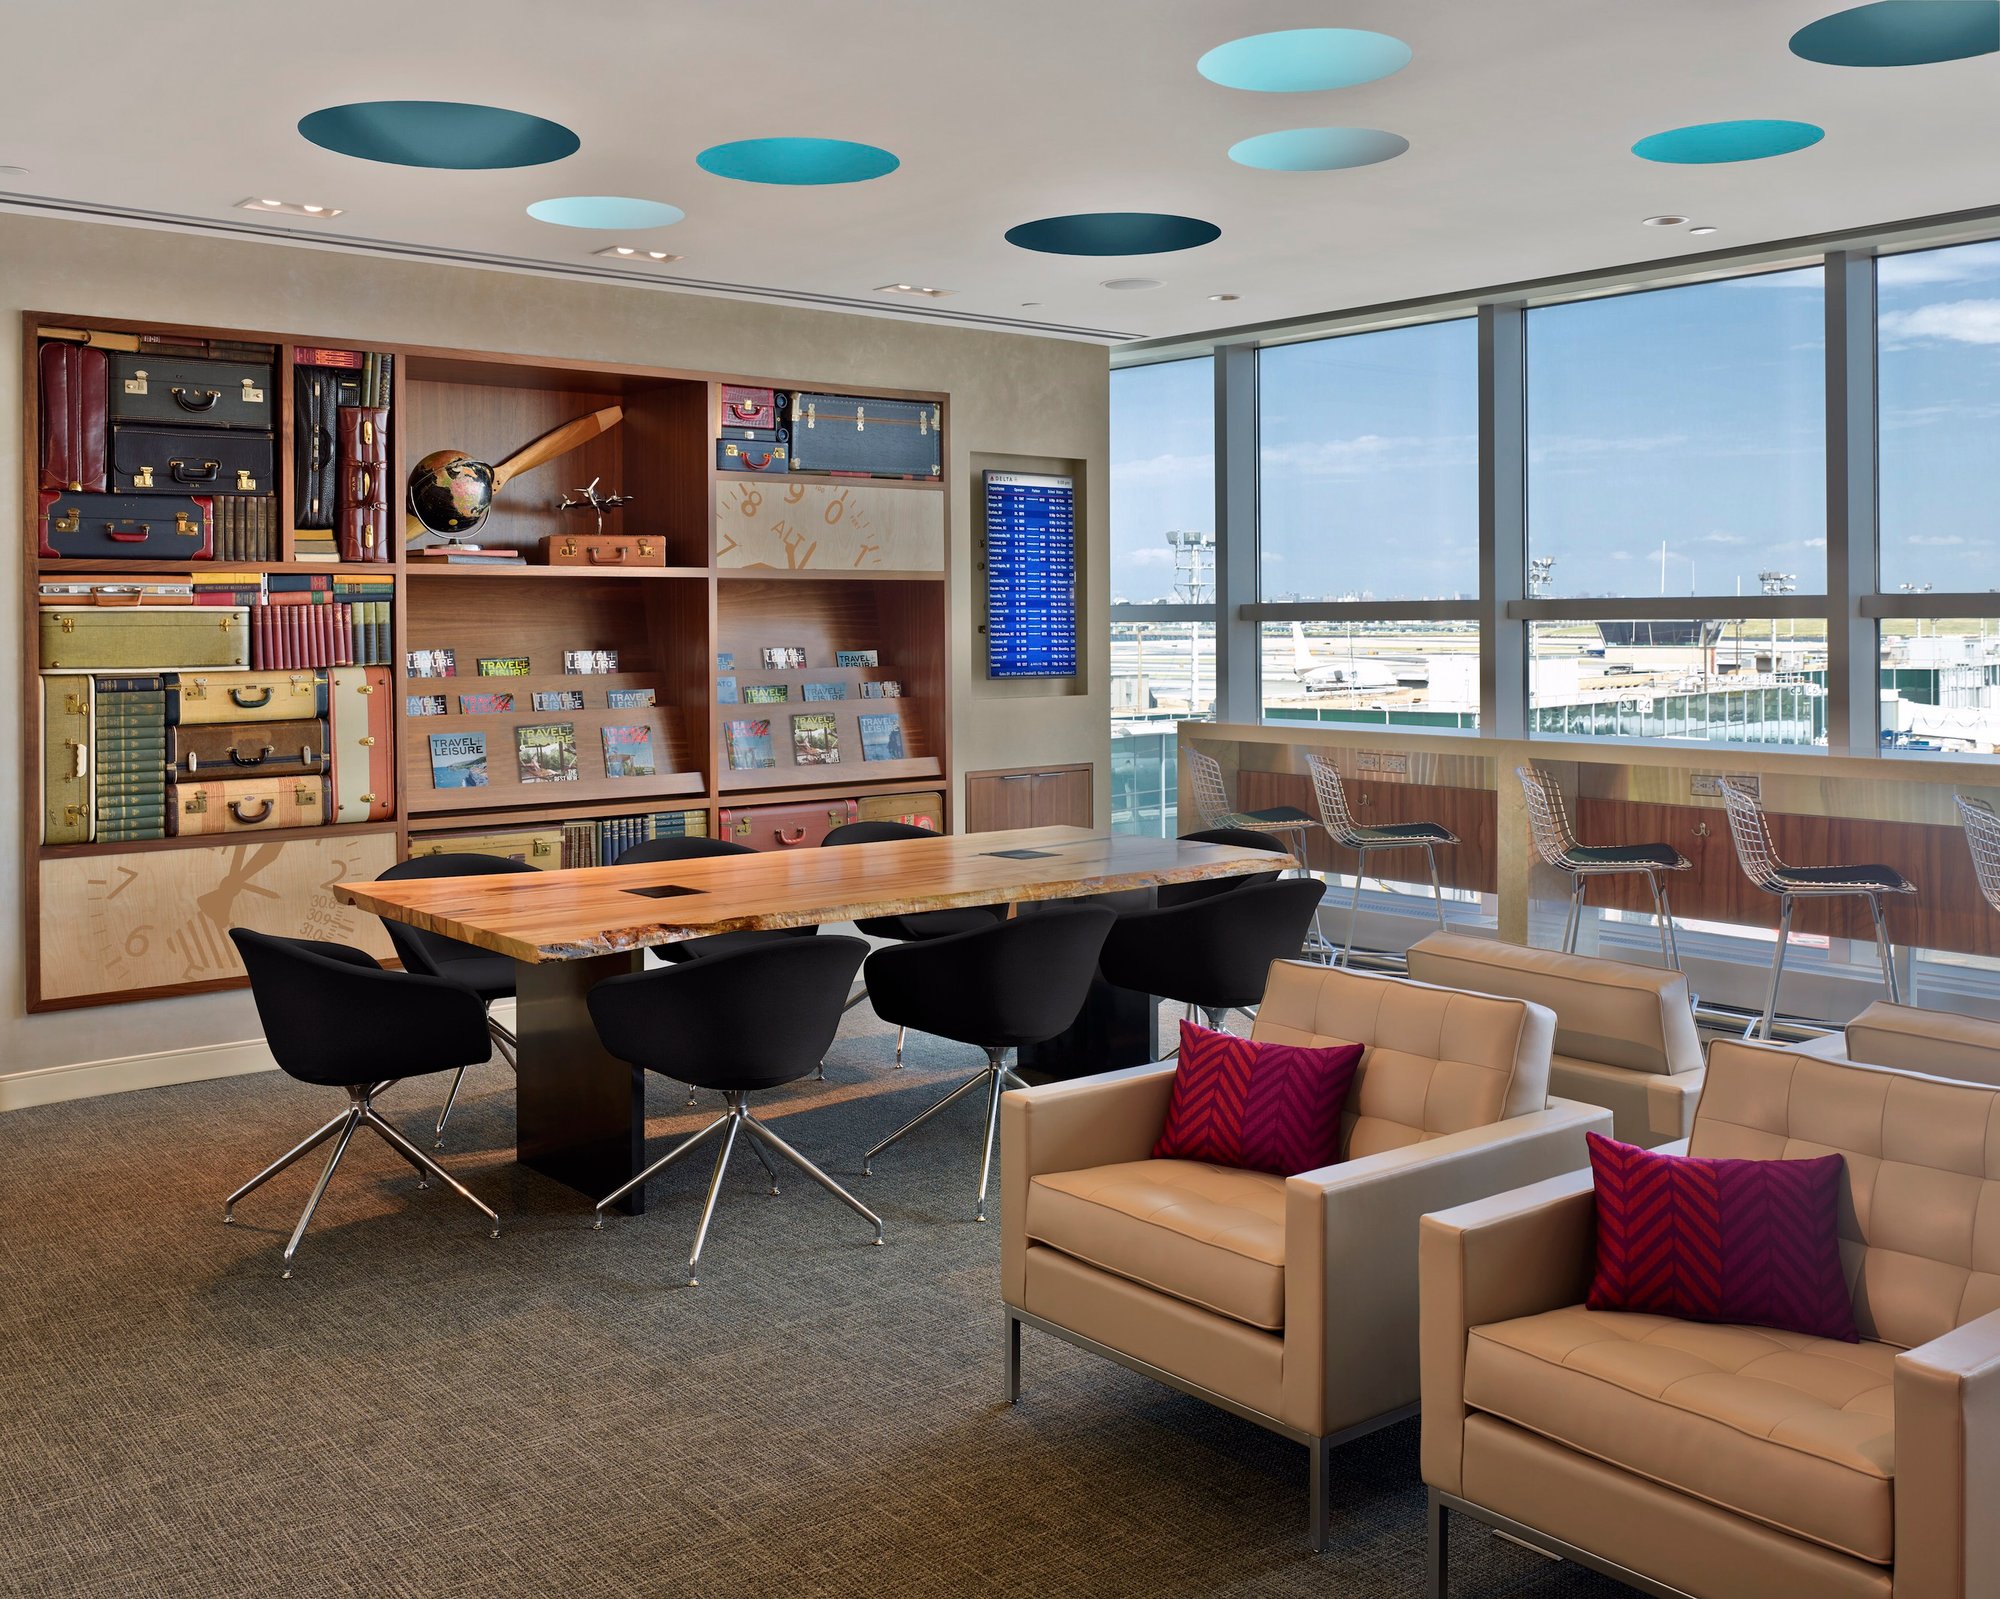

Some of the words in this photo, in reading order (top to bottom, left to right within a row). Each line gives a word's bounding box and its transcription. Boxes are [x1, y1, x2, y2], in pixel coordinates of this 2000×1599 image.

[784, 483, 805, 505] 9
[741, 490, 763, 517] 8
[568, 660, 617, 669] LEISURE
[407, 695, 445, 706] AVEL+
[536, 700, 583, 710] LEISURE
[1638, 700, 1651, 711] C4
[407, 704, 446, 715] ISURE
[434, 745, 484, 756] LEISURE
[320, 859, 347, 891] 2
[311, 894, 337, 909] 30.8
[306, 907, 332, 925] 30.9
[125, 925, 154, 957] 6
